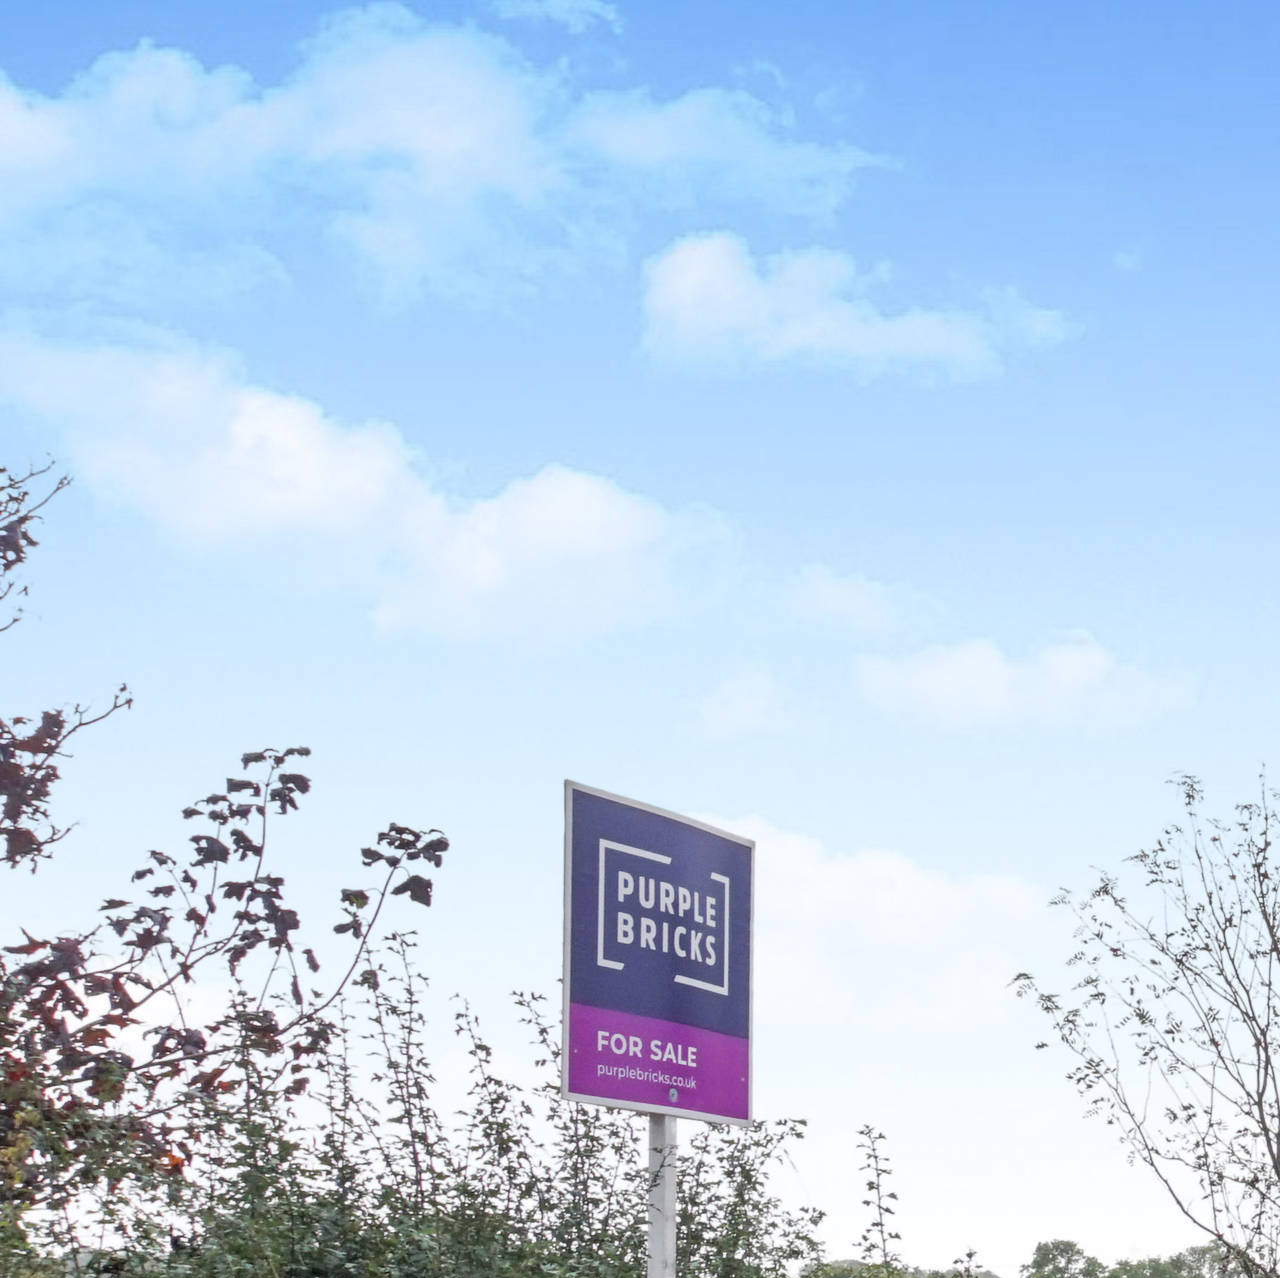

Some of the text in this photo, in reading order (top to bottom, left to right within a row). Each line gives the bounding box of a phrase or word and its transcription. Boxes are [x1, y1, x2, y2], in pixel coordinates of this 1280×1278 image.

[617, 870, 717, 928] PURPLE
[617, 911, 717, 967] BRICKS
[597, 1030, 697, 1068] FOR SALE
[597, 1063, 697, 1089] purplebricks.co.uk
